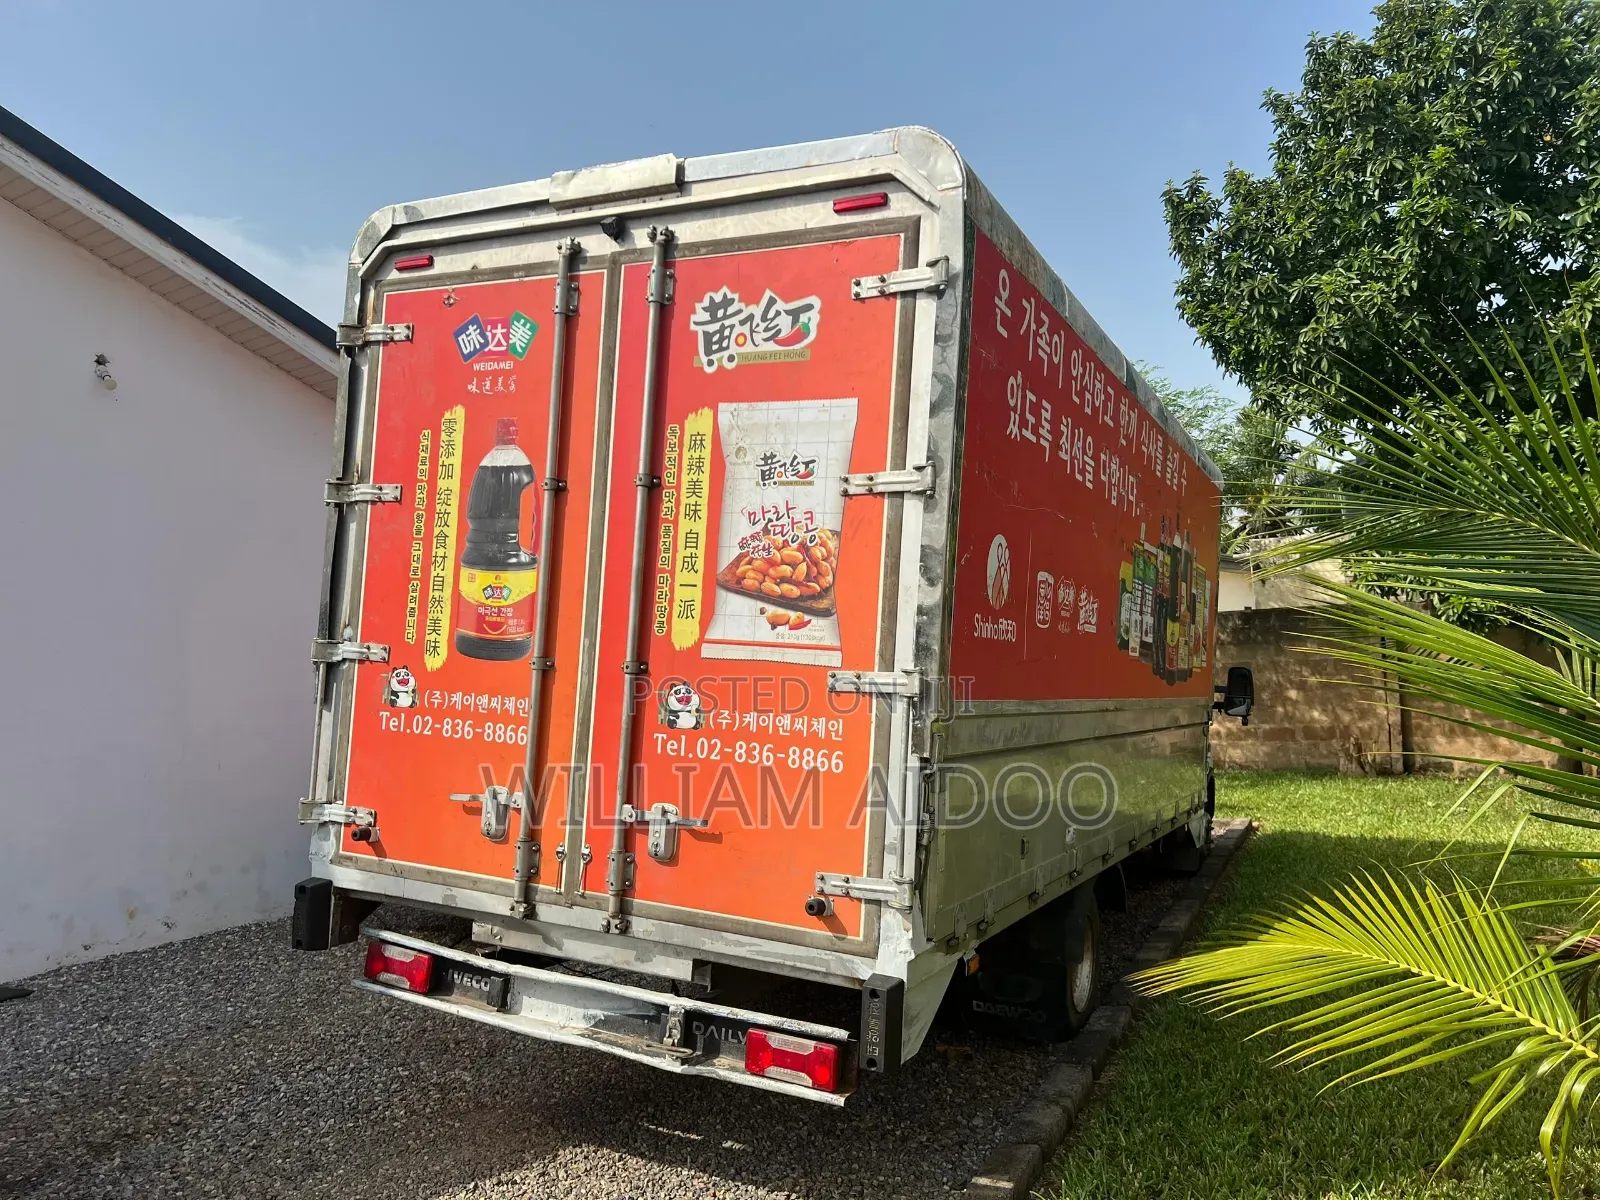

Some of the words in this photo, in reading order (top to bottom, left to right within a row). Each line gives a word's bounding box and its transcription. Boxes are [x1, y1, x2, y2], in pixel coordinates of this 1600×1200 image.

[458, 319, 533, 355] 味达美
[473, 360, 514, 372] WEIDAMEI
[741, 354, 768, 362] HUANG
[769, 353, 782, 361] FEI
[783, 351, 806, 360] HONG
[994, 268, 1012, 339] 온
[1020, 296, 1065, 389] 가족이
[1071, 349, 1115, 428] 안심하고
[1119, 395, 1138, 454] 한끼
[1140, 420, 1163, 478] 식사를
[1180, 460, 1187, 497] 수
[418, 430, 431, 480] 식재료의
[665, 425, 680, 485] 독보적인
[1006, 369, 1053, 463] 있도록
[1058, 415, 1095, 490] 최선을
[1100, 449, 1140, 518] 다합니다.
[416, 484, 427, 508] 맛과
[662, 490, 676, 519] 맛과
[747, 500, 797, 527] 마라
[414, 512, 425, 537] 향을
[770, 510, 819, 544] 땅콩
[411, 541, 422, 577] 그대로
[659, 525, 673, 568] 품질의
[405, 581, 420, 643] 살려줍니다
[655, 575, 670, 635] 마라땅콩
[424, 689, 528, 718] (주)케이앤씨체인
[379, 711, 528, 746] Tel.02-836-8866
[709, 707, 844, 741] (주)케이앤씨체인
[653, 733, 844, 774] Tel.02-836-8866
[447, 969, 491, 992] IVECO
